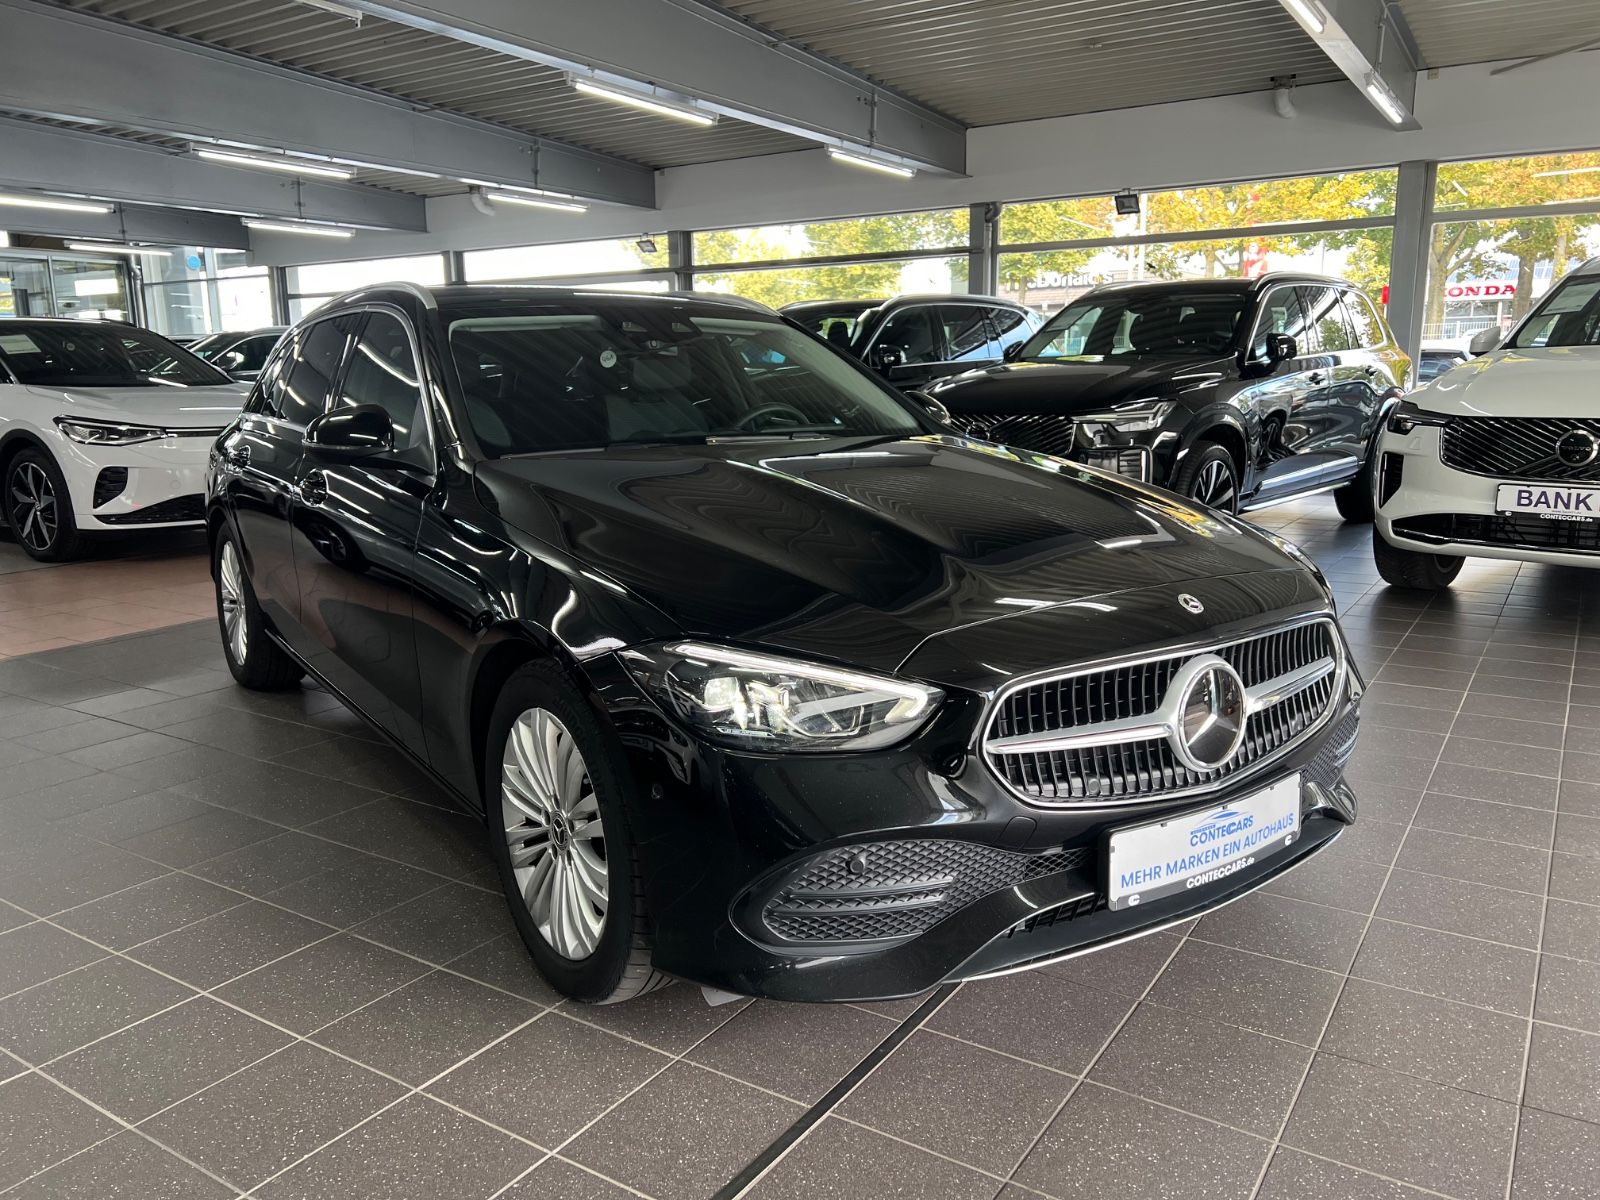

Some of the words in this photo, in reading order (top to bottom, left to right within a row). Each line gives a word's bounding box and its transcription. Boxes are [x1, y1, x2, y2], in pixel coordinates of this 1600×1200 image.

[1444, 284, 1516, 297] ONDA
[1517, 489, 1594, 512] BANK
[1121, 866, 1161, 888] MEHR
[1166, 848, 1220, 876] MARKEN
[1223, 845, 1241, 857] EIN
[1243, 813, 1294, 849] AUTOHAUS
[1186, 856, 1255, 889] CONTECCARS.de
